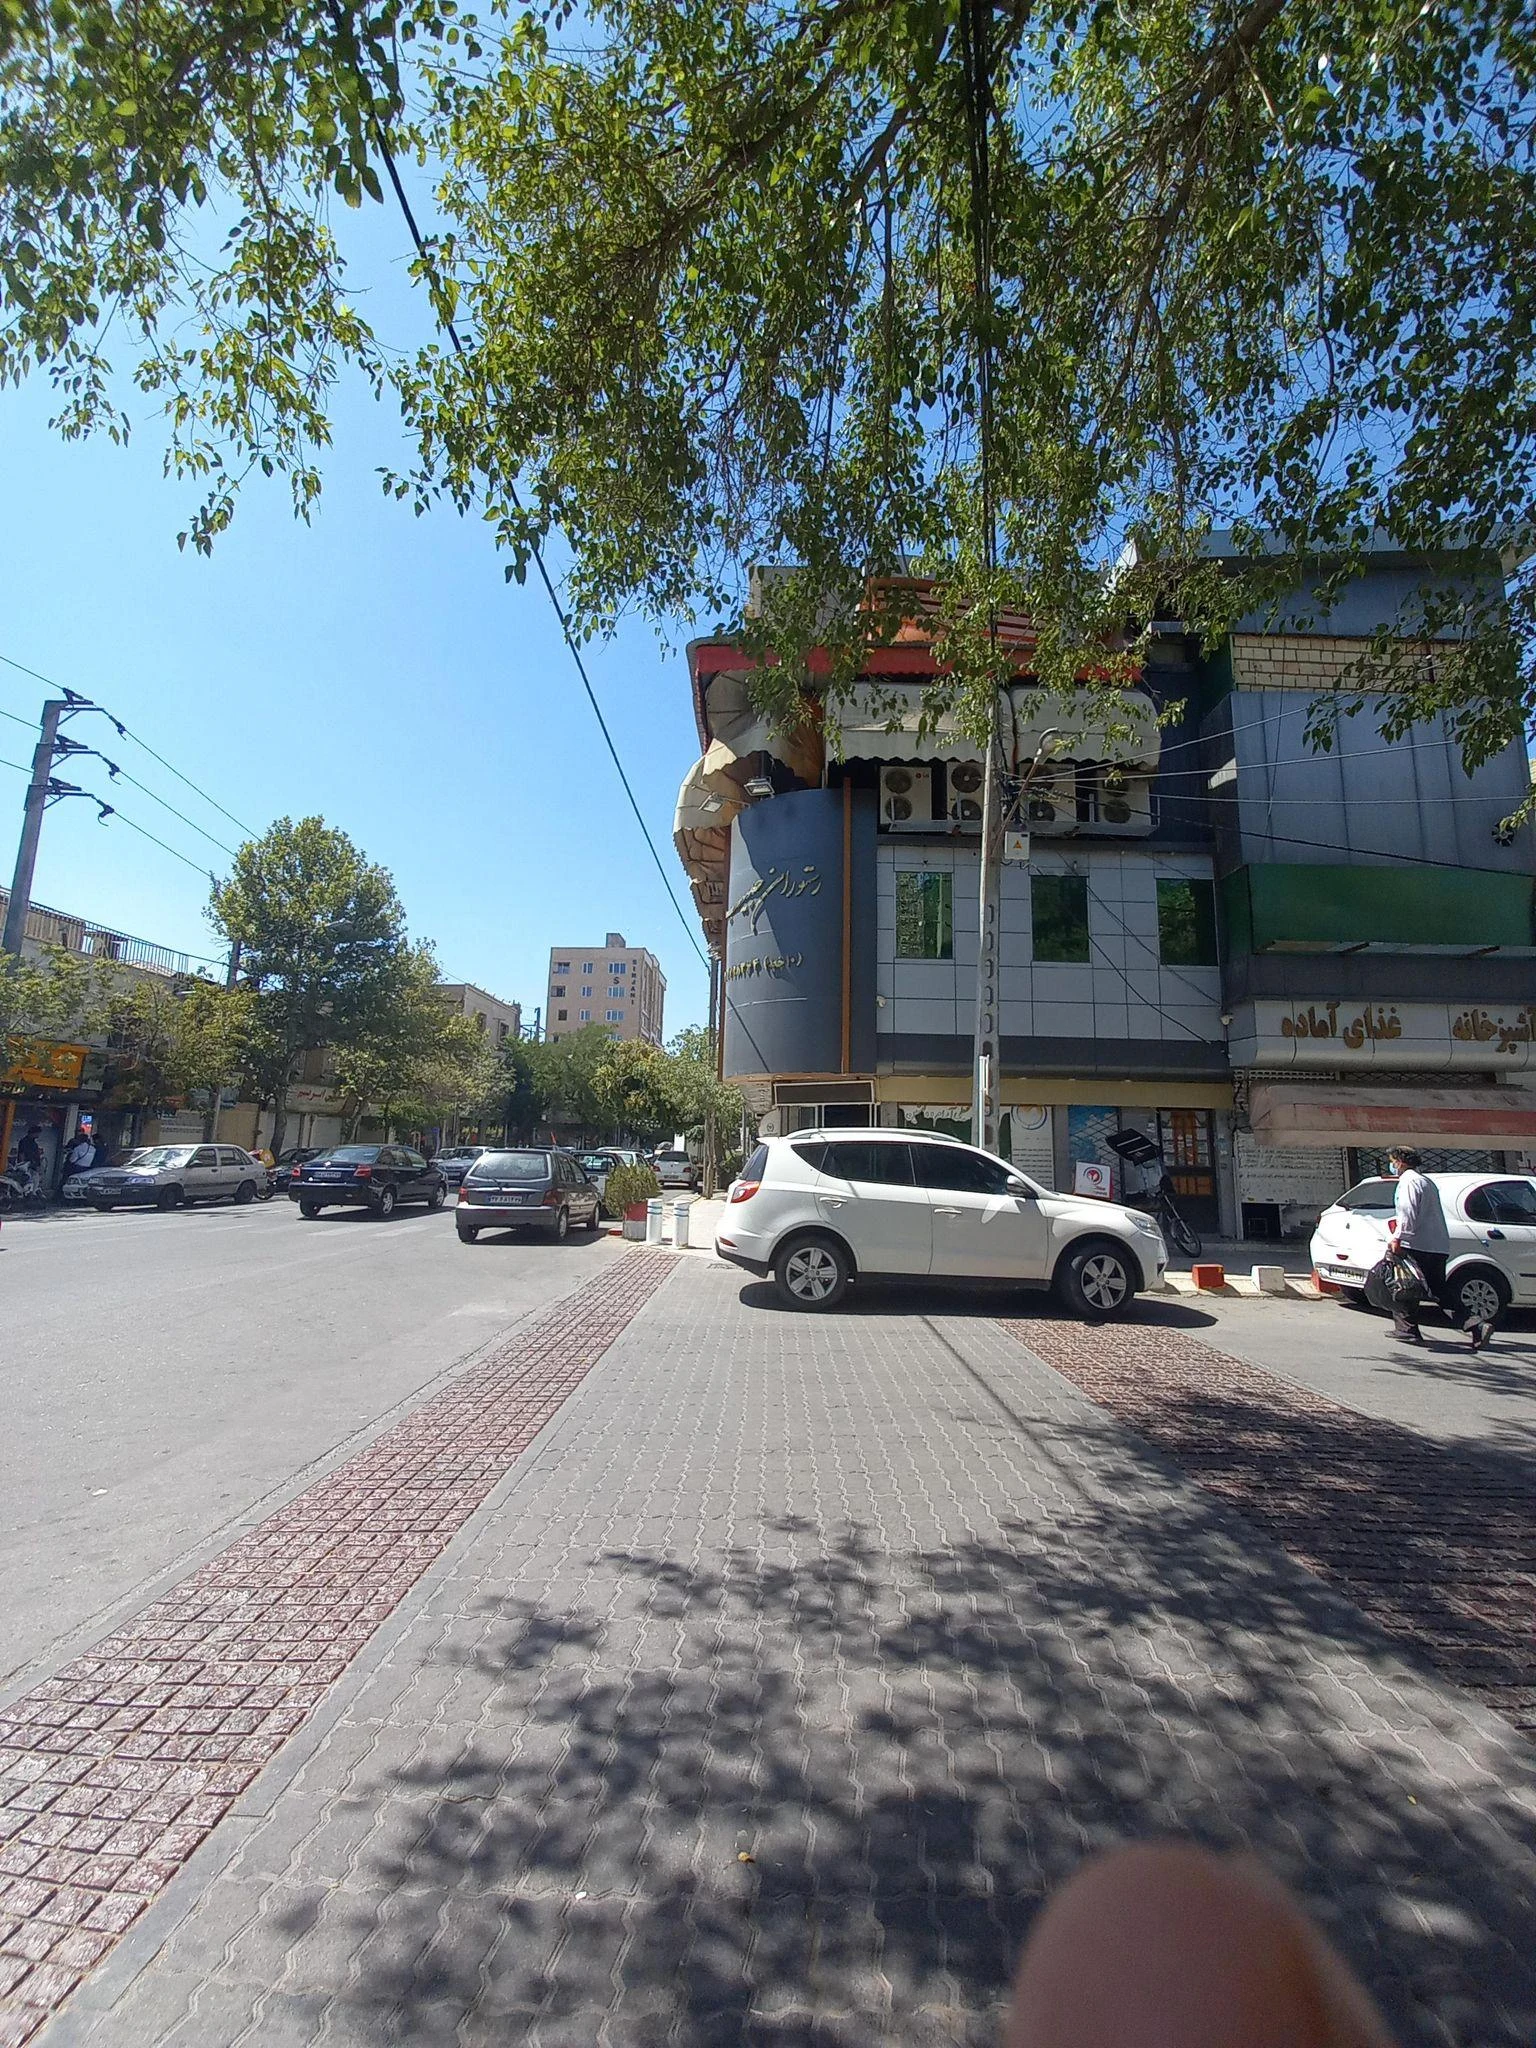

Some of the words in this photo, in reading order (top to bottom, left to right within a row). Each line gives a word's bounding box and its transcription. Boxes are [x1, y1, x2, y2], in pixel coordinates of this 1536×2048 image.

[612, 976, 621, 985] S
[1281, 1001, 1341, 1039] آماده
[1343, 1005, 1403, 1049] غذای
